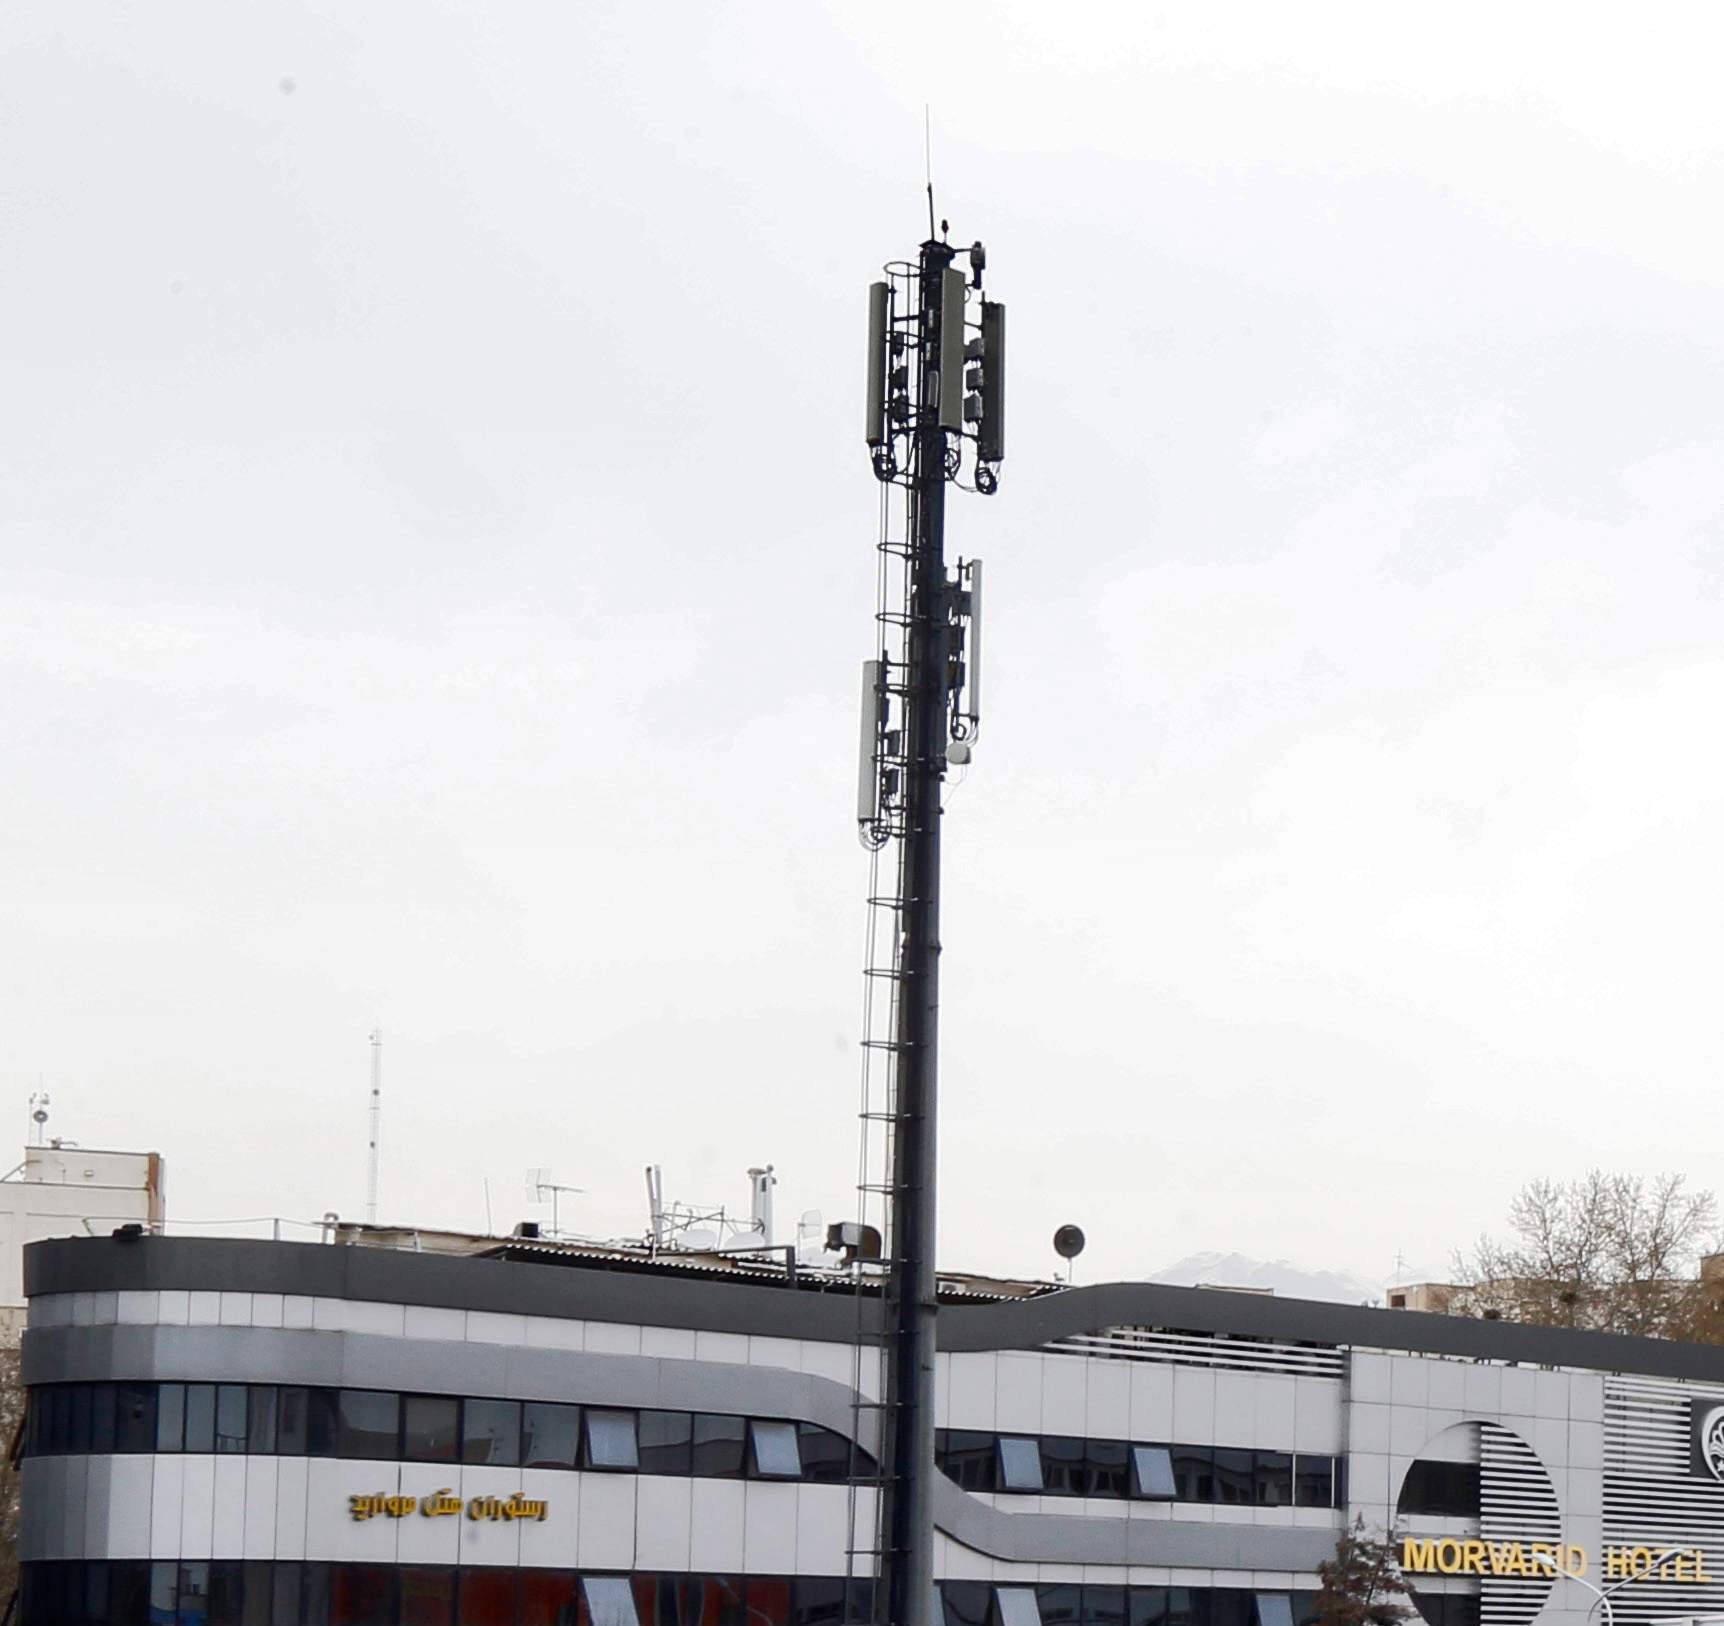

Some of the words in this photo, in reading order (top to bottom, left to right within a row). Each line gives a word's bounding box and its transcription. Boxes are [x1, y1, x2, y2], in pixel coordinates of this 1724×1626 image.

[349, 1491, 417, 1521] مروارید
[420, 1488, 464, 1517] هتل
[467, 1491, 549, 1521] رستوران
[1403, 1537, 1589, 1579] MORVARID
[1606, 1546, 1713, 1583] HOTEL
